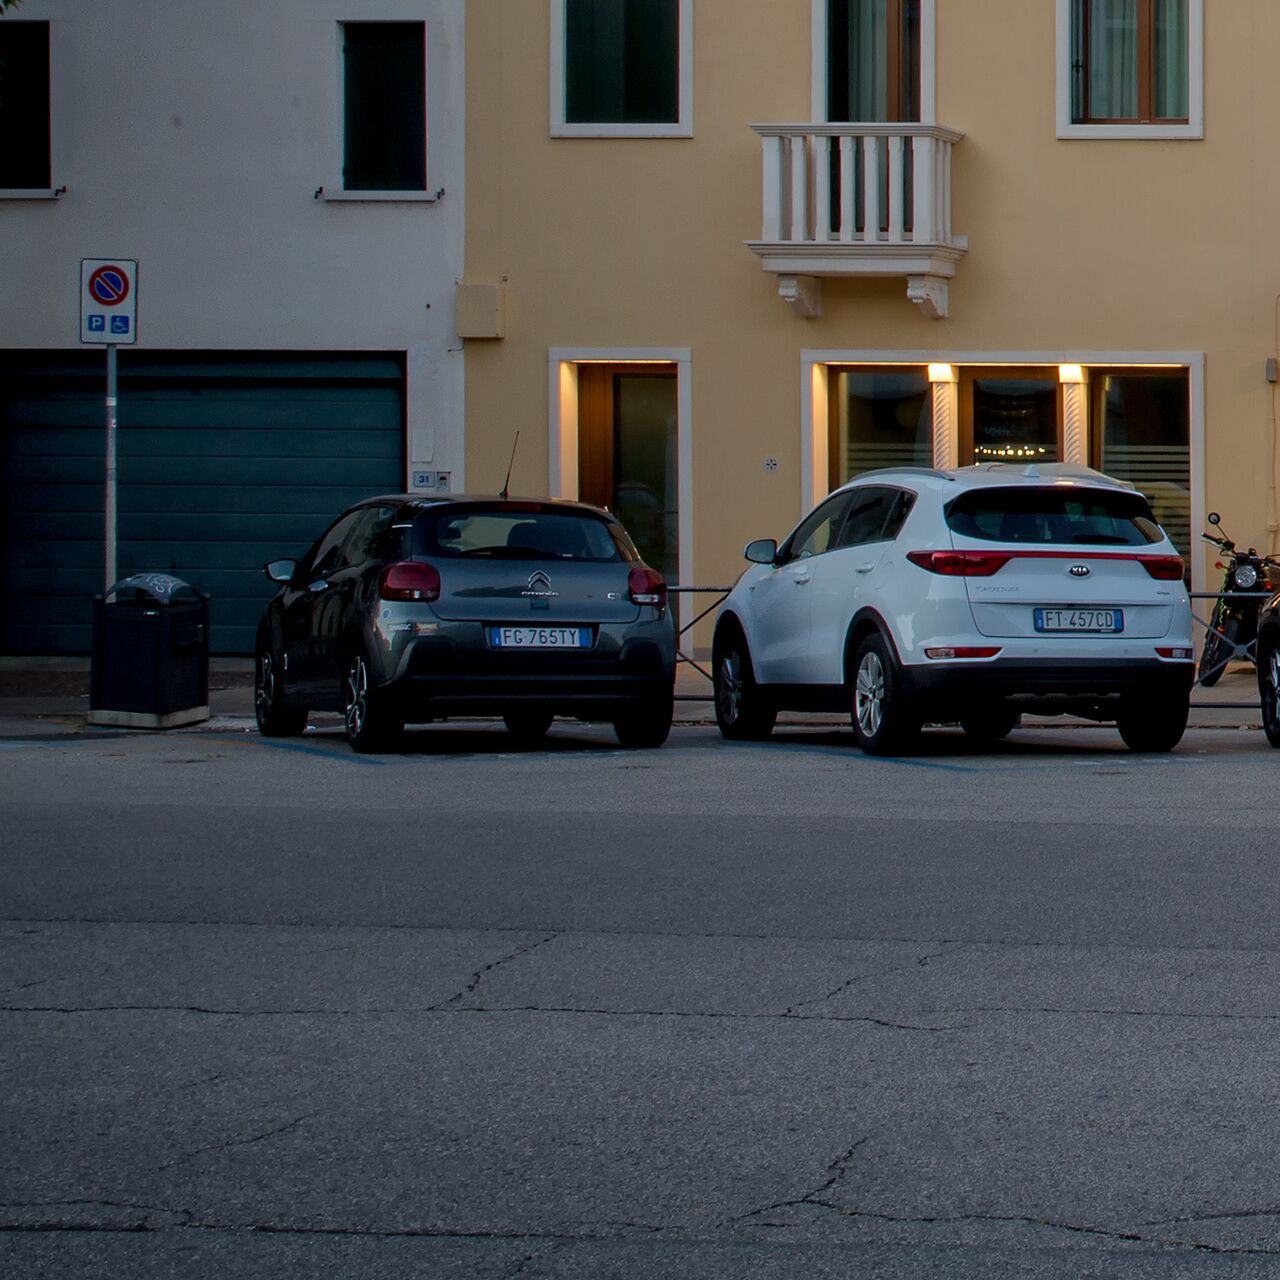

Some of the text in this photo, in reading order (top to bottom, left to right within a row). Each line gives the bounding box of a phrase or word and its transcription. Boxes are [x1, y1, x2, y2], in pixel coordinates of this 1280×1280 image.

[91, 316, 103, 330] P
[418, 475, 430, 484] 31
[1045, 611, 1114, 628] FT 457CD
[504, 628, 578, 646] FG 765TY
